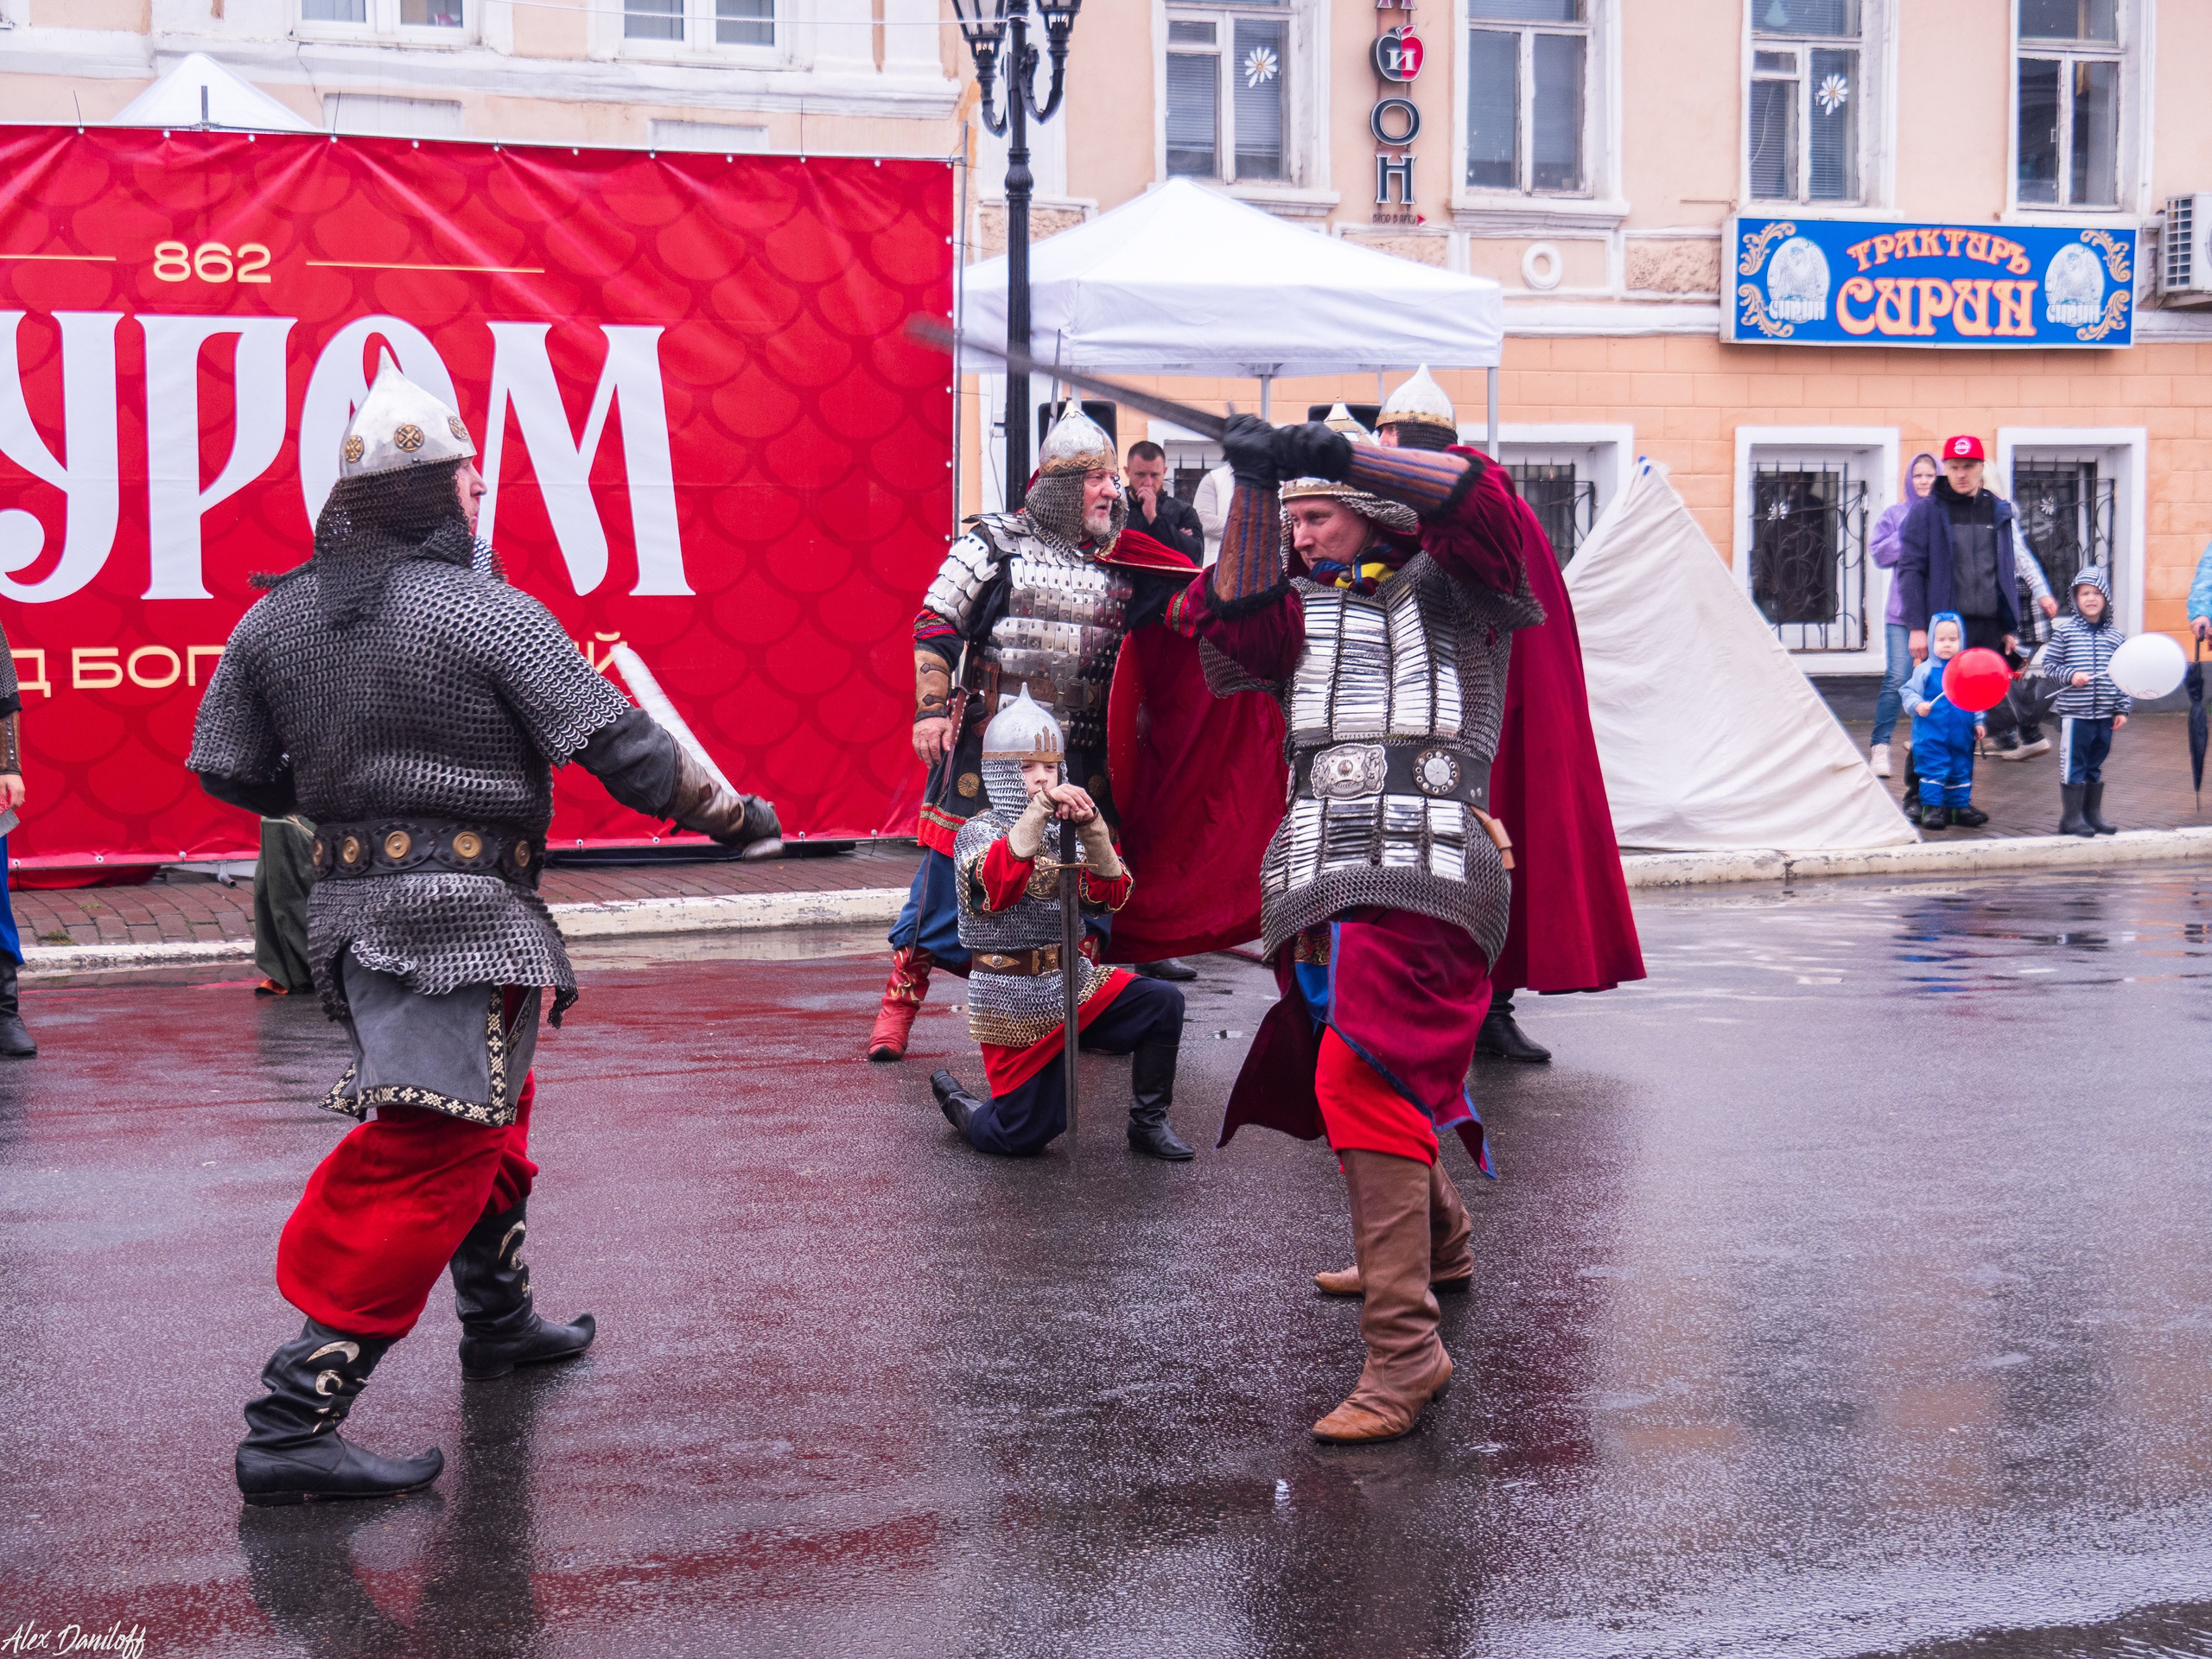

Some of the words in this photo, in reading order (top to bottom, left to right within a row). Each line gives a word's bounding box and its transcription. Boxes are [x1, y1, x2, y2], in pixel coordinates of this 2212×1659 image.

[1372, 213, 1391, 224] ВХОД
[152, 241, 272, 283] 862
[1847, 228, 2031, 275] ТРАКТИРЪ
[1836, 276, 2038, 336] СИРИН
